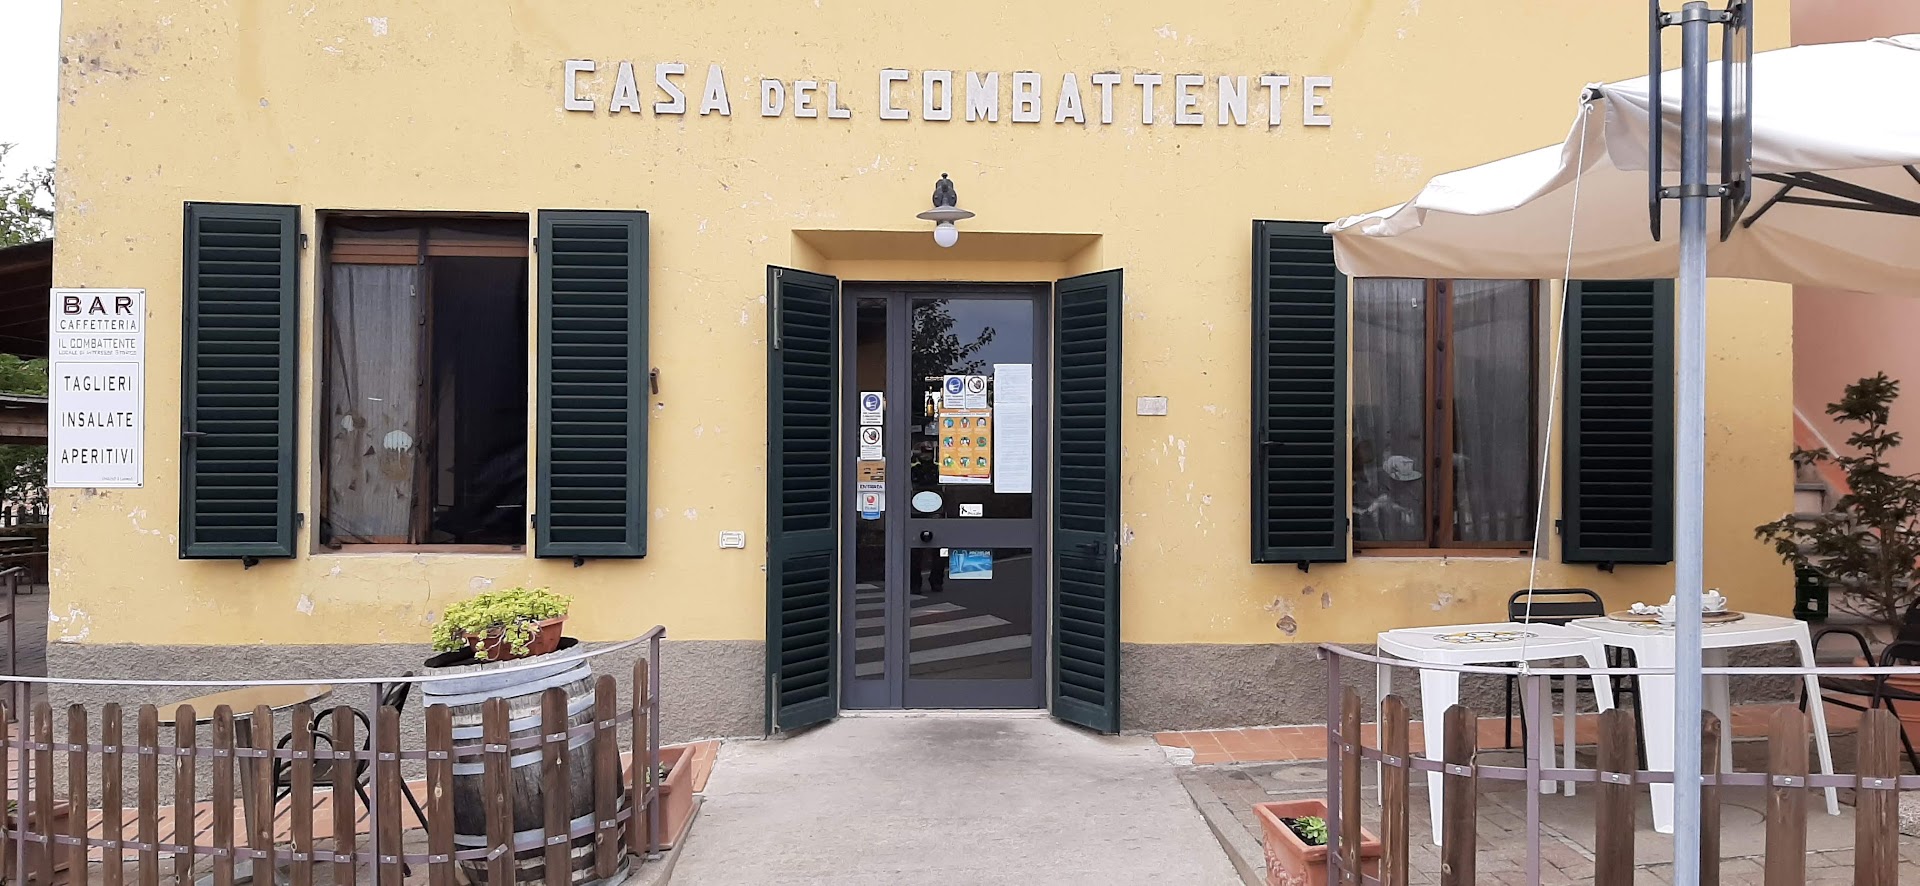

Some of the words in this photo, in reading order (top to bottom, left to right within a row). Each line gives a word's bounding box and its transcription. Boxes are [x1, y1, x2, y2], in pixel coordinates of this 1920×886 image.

[563, 59, 731, 117] CASA
[760, 79, 852, 119] DEL
[878, 68, 1334, 128] COMBATTENTE
[63, 295, 134, 316] BAR
[60, 319, 137, 331] CAFFETTERIA
[58, 338, 67, 349] IL
[70, 338, 136, 349] COMBATTENTE
[64, 376, 131, 391] TAGLIERI
[62, 412, 133, 427] INSALATE
[61, 448, 133, 464] APERITIVI
